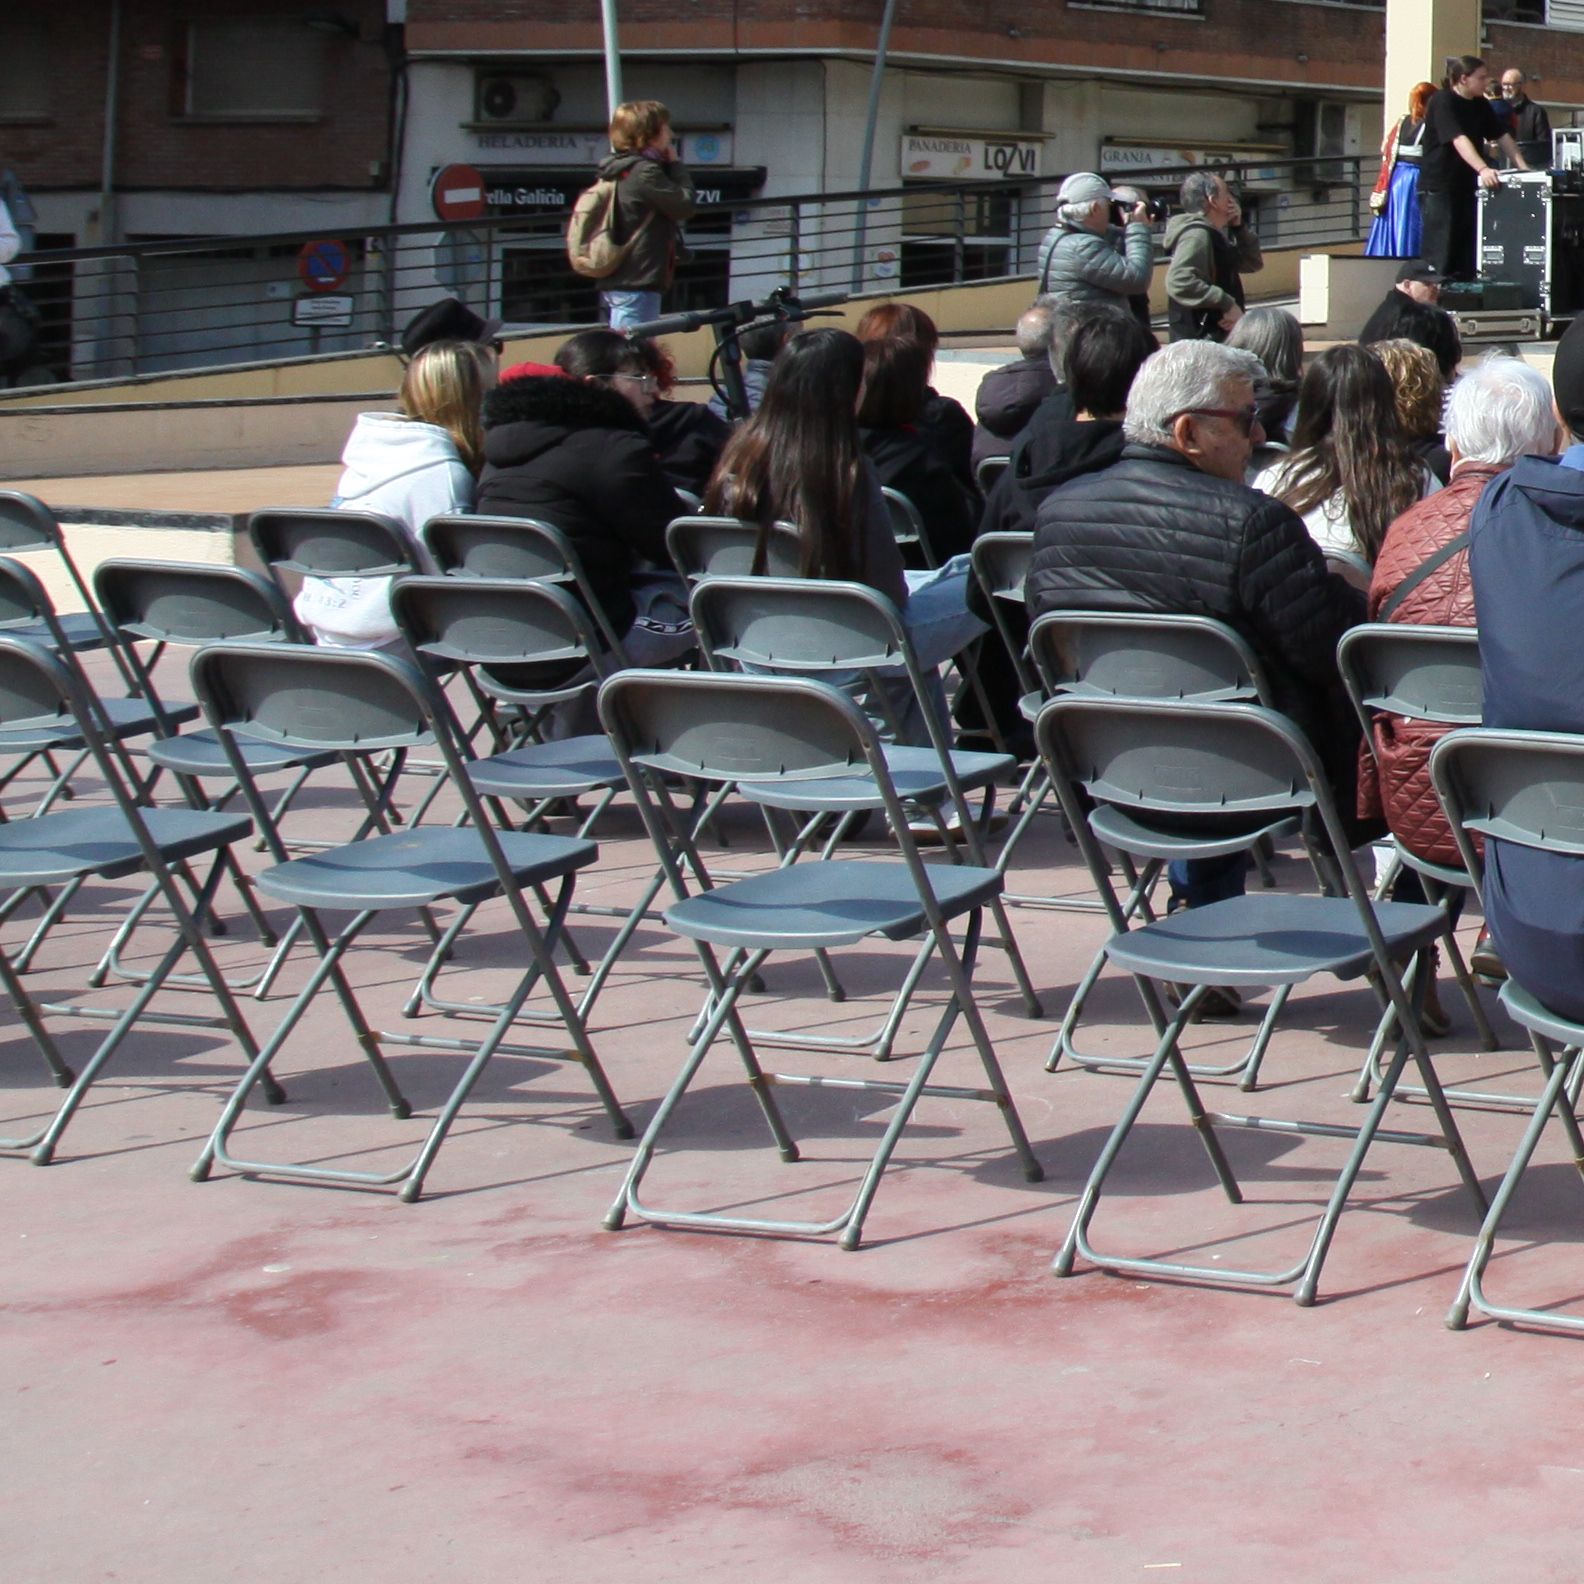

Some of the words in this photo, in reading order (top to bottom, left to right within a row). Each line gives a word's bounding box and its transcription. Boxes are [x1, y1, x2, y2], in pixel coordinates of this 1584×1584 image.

[477, 135, 577, 149] HELADERIA
[908, 138, 972, 154] PANADERIA
[514, 188, 565, 205] Galicia
